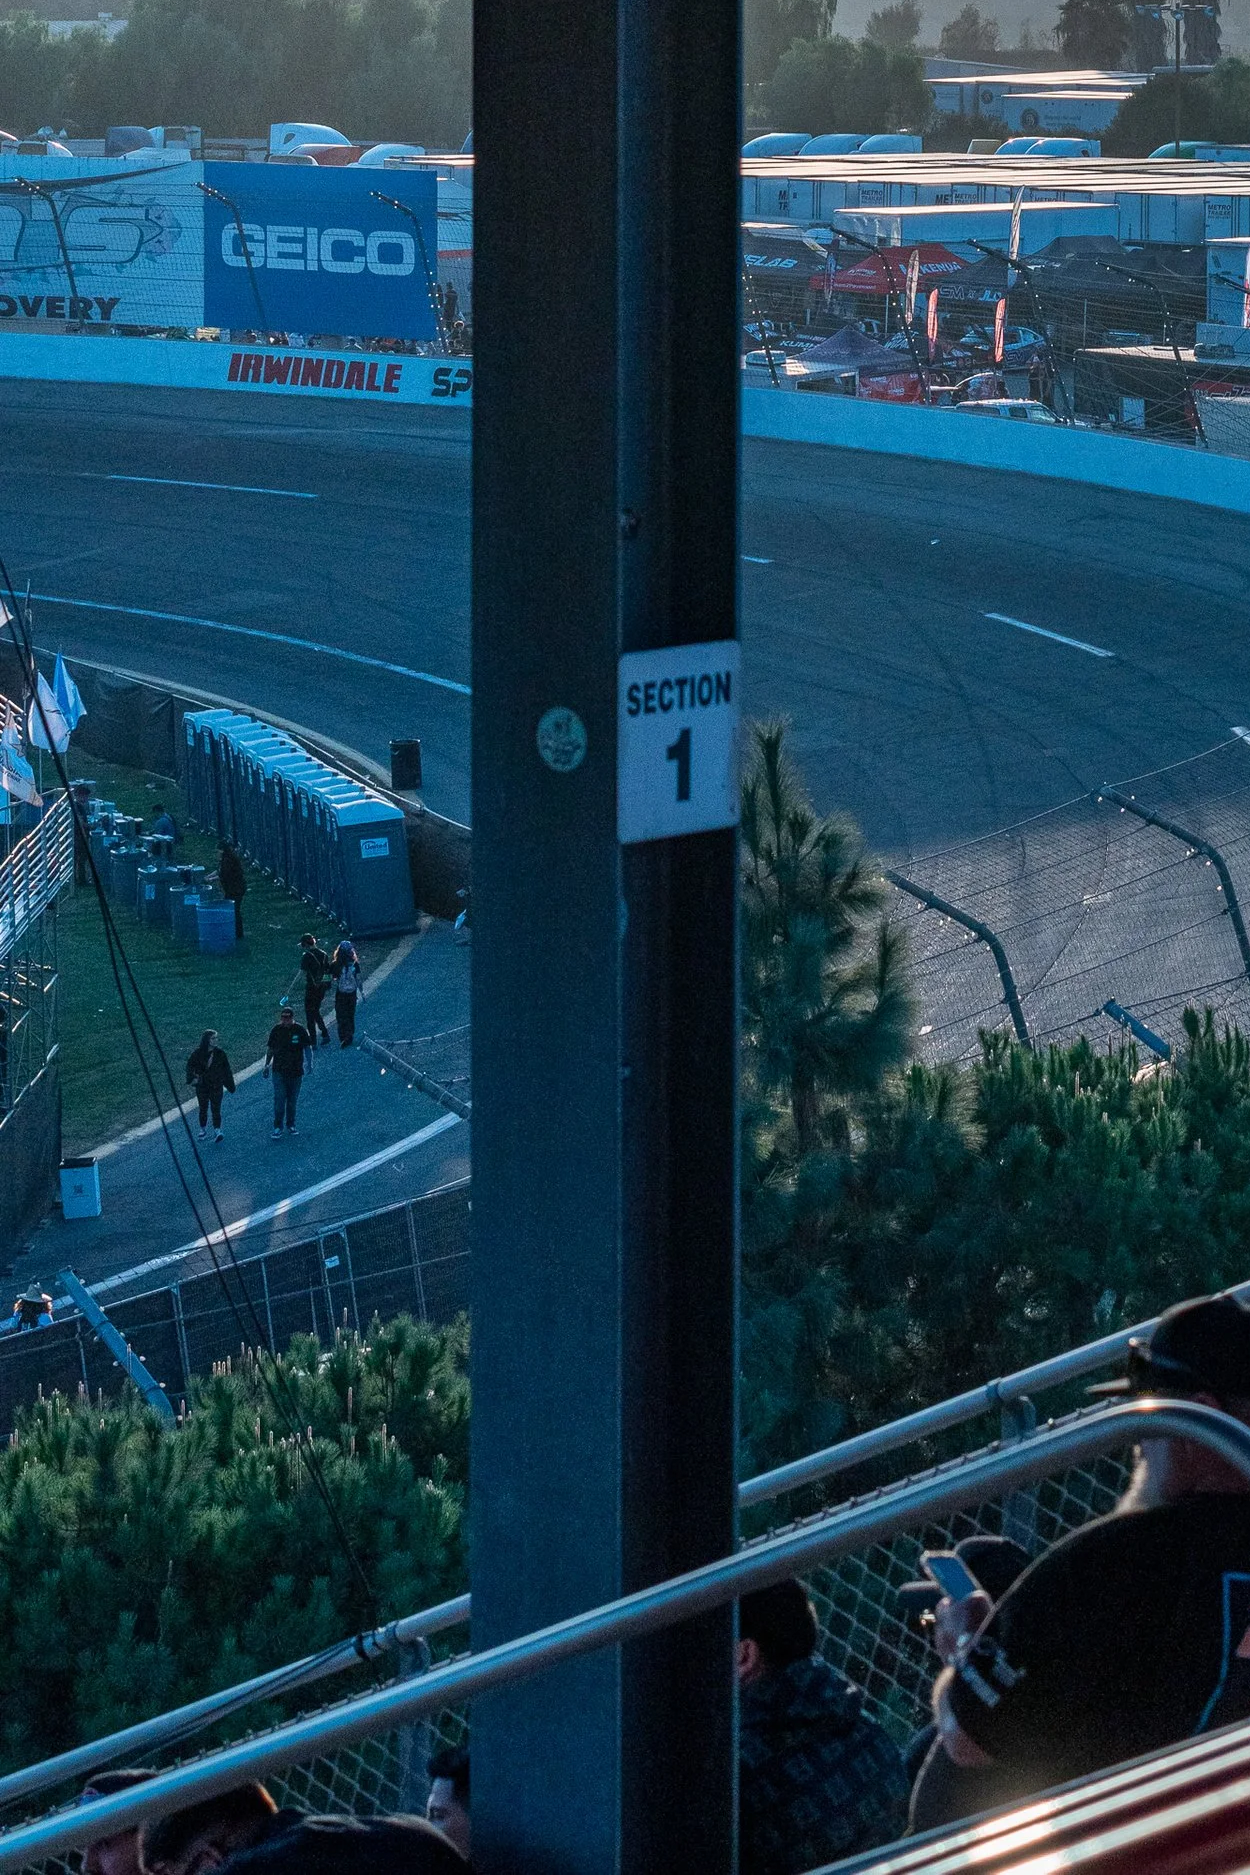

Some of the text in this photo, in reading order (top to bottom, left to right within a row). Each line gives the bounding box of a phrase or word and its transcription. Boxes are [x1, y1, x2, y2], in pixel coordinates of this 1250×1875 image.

[221, 222, 415, 276] GEICO
[227, 352, 403, 394] IRWINDALE
[627, 670, 732, 716] SECTION
[666, 727, 691, 801] 1
